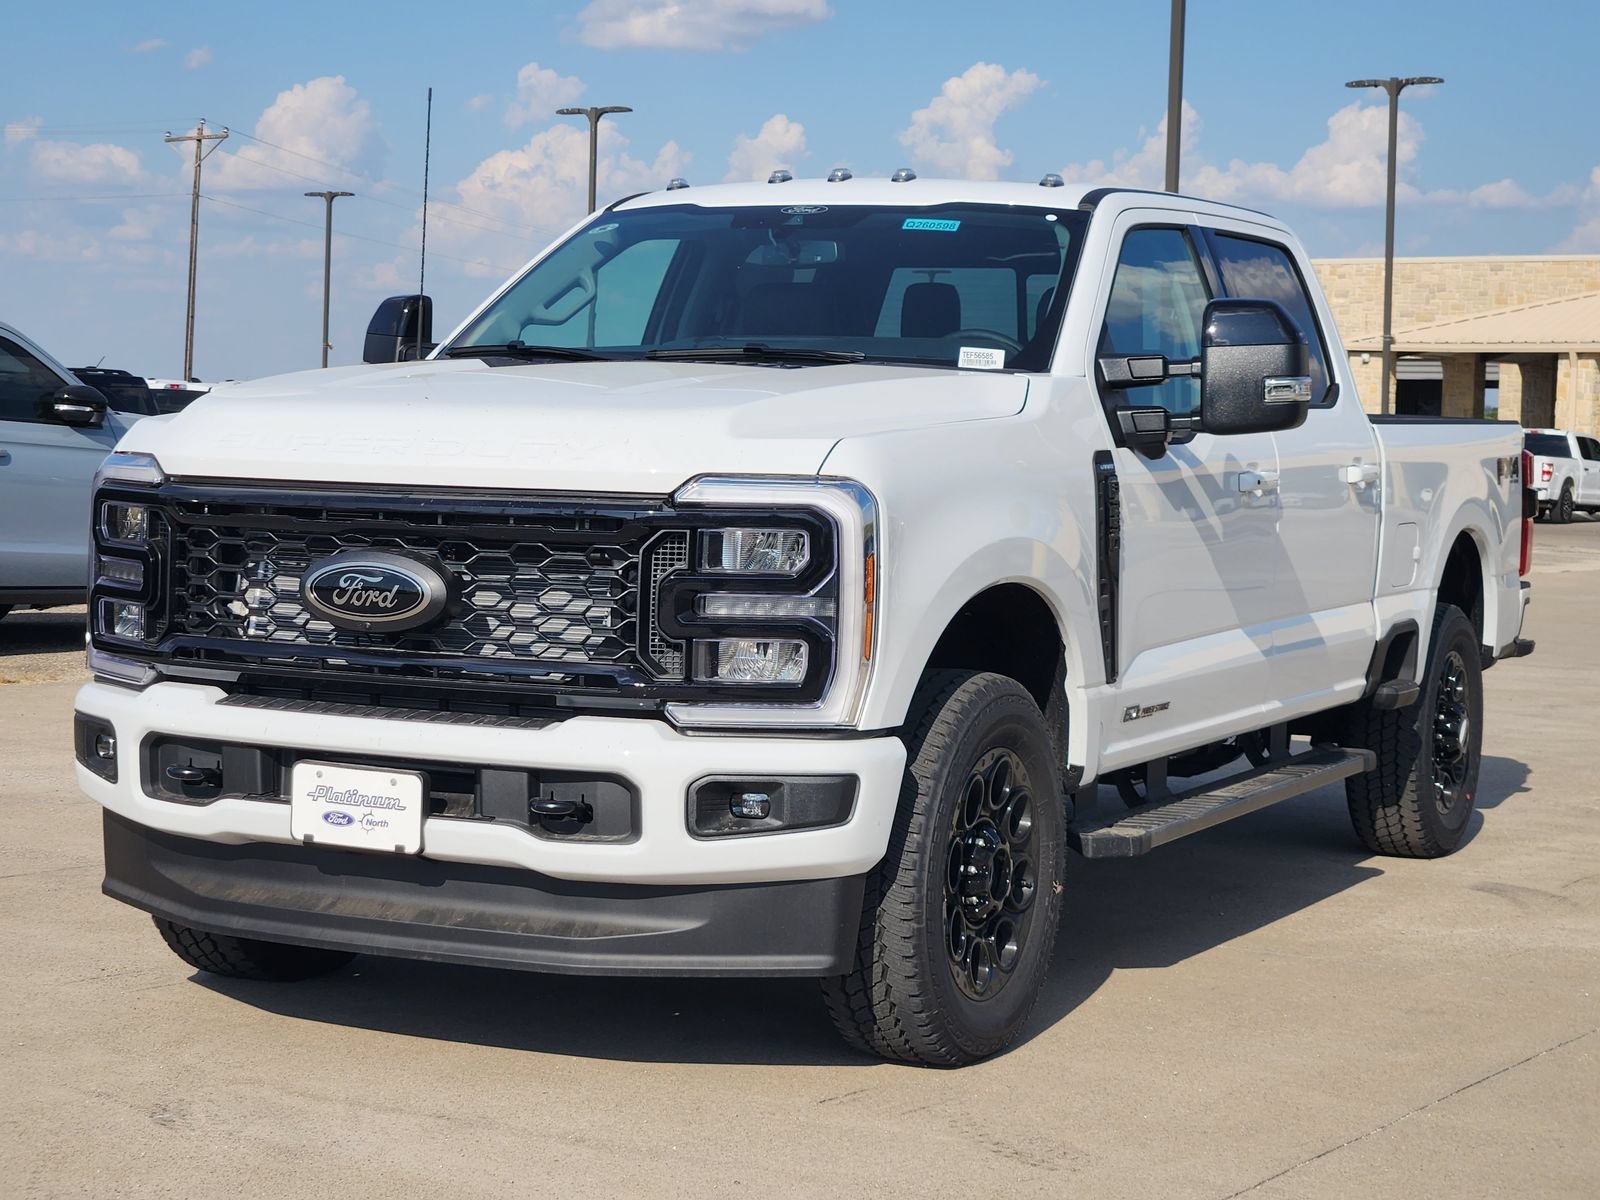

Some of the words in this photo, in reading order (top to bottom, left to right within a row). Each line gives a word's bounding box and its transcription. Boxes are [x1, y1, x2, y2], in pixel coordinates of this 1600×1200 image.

[905, 220, 957, 230] Q260598
[332, 572, 400, 609] Ford
[307, 784, 408, 811] Platinum
[327, 812, 350, 826] Ford
[365, 818, 389, 829] North
